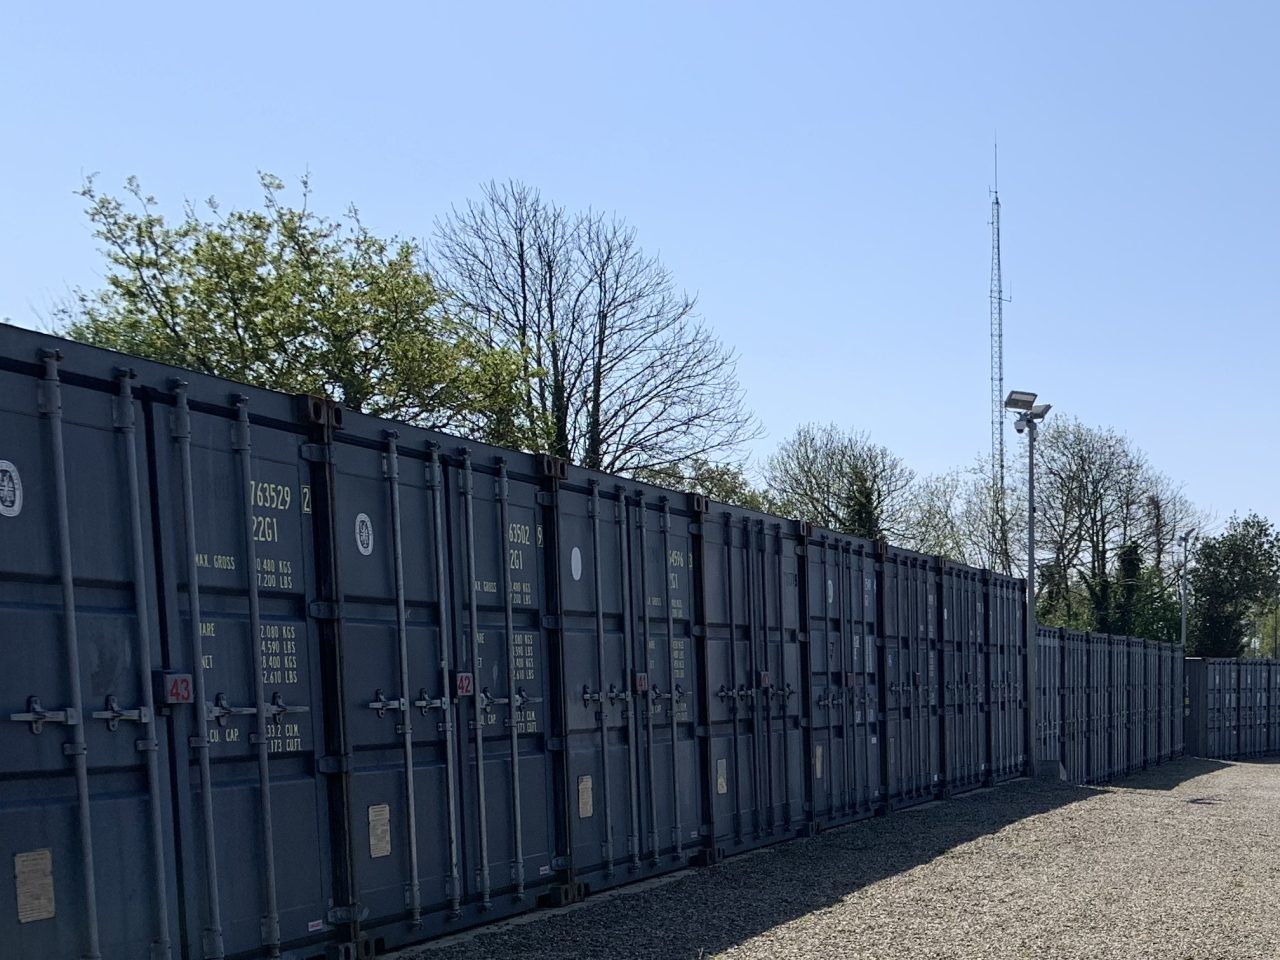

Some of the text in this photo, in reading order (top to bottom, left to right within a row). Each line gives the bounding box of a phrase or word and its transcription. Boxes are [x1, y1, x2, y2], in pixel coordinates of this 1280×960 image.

[250, 480, 291, 510] 763529
[252, 516, 278, 542] 22G1
[508, 523, 531, 546] 63502
[213, 555, 236, 570] GROSS
[279, 560, 292, 574] KGS
[510, 549, 523, 570] 2G1
[256, 573, 293, 589] 7.200 LBS
[282, 626, 296, 639] KGS
[283, 641, 296, 654] LBS
[284, 656, 297, 669] KGS
[264, 671, 298, 684] 2.610 LBS
[458, 675, 471, 694] 42
[169, 678, 191, 702] 43
